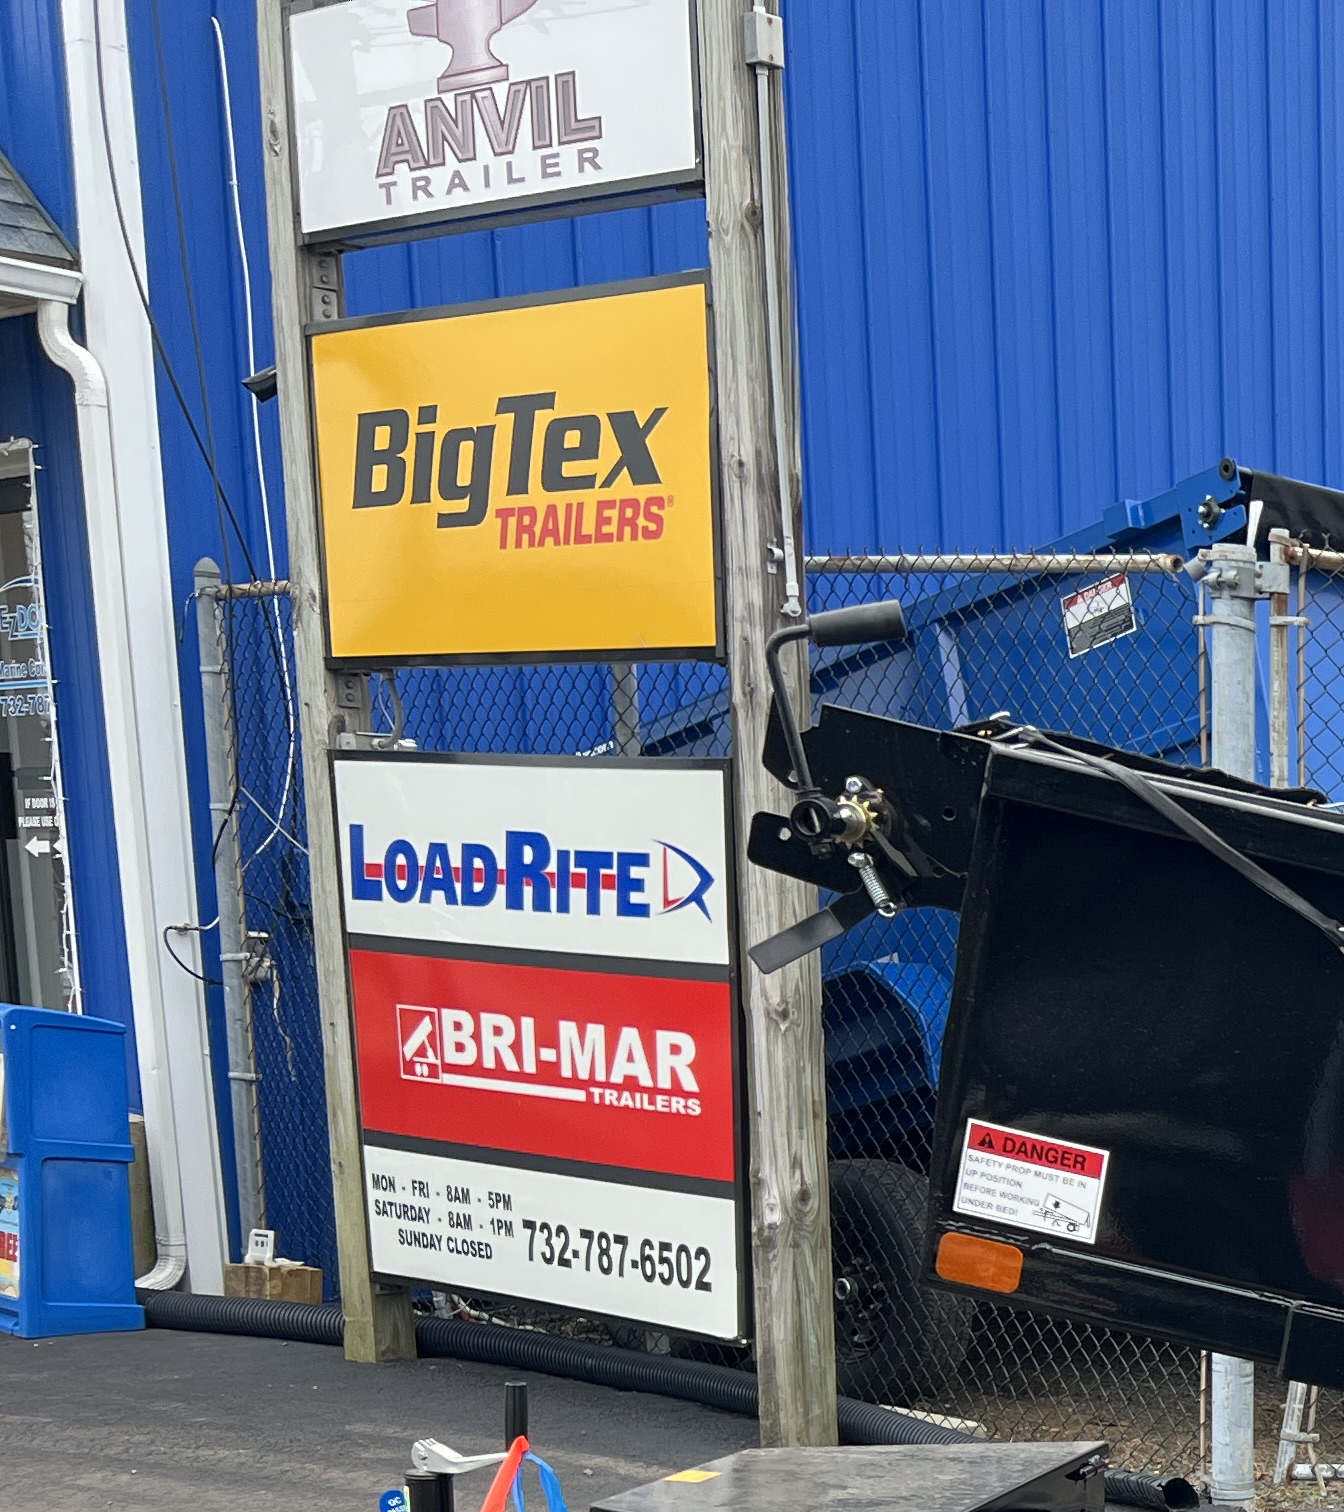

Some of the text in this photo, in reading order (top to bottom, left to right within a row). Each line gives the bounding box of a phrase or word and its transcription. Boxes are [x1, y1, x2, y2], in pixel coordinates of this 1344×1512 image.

[375, 70, 603, 179] ANVIL
[378, 146, 604, 205] TRAILER
[352, 391, 670, 528] BigTex
[495, 496, 667, 550] TRAILERS
[441, 1008, 701, 1093] BRI-MAR
[589, 1087, 703, 1117] TRAILERS
[968, 1154, 1004, 1169] SAFETY
[1005, 1162, 1032, 1175] PROP
[1034, 1170, 1060, 1183] MUST
[1062, 1176, 1076, 1186] BE
[1002, 1137, 1087, 1172] DANGER
[372, 1173, 396, 1193] MON
[411, 1179, 430, 1199] FRI
[446, 1185, 471, 1205] 8AM
[488, 1191, 513, 1212] 5PM
[962, 1182, 1040, 1208] BEFORE WORKING
[965, 1168, 1023, 1189] UP POSITION
[374, 1199, 431, 1225] SATURDAY
[448, 1211, 473, 1231] 8AM
[490, 1218, 514, 1238] 1PM
[961, 1196, 994, 1211] UNDER
[398, 1228, 493, 1260] SUNDAY CLOSED
[522, 1218, 712, 1293] 732-787-6502
